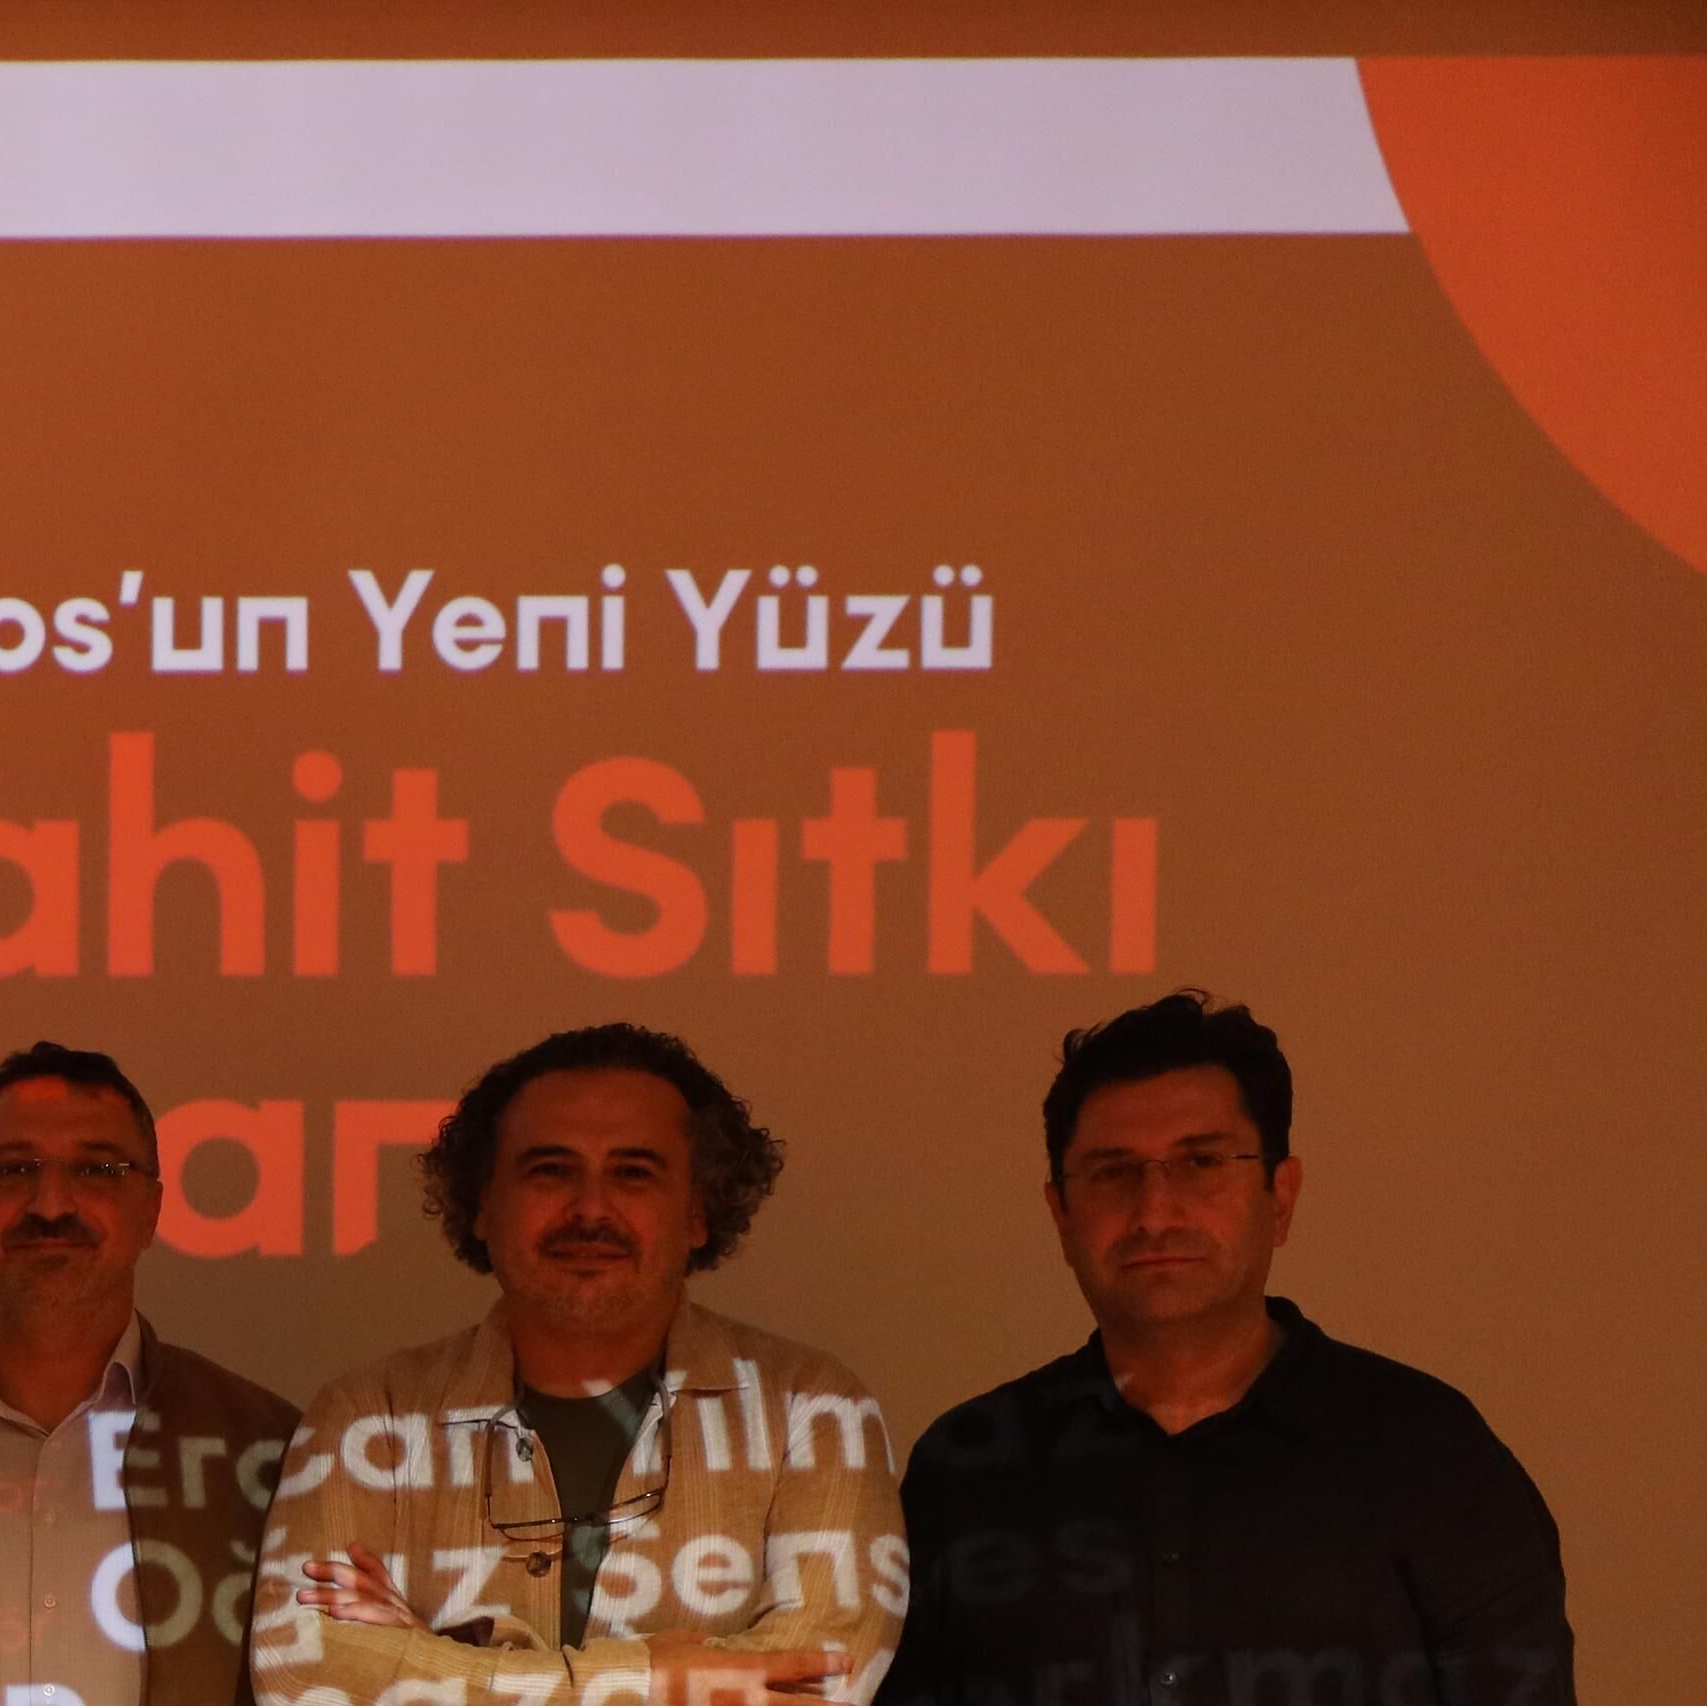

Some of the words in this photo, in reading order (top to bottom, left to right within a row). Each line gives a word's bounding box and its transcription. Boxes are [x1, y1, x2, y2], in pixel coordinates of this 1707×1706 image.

[347, 563, 626, 672] Yeni
[665, 563, 994, 672] Yüzü
[548, 729, 1161, 979] Sıtkı
[87, 1403, 535, 1513] Ercan
